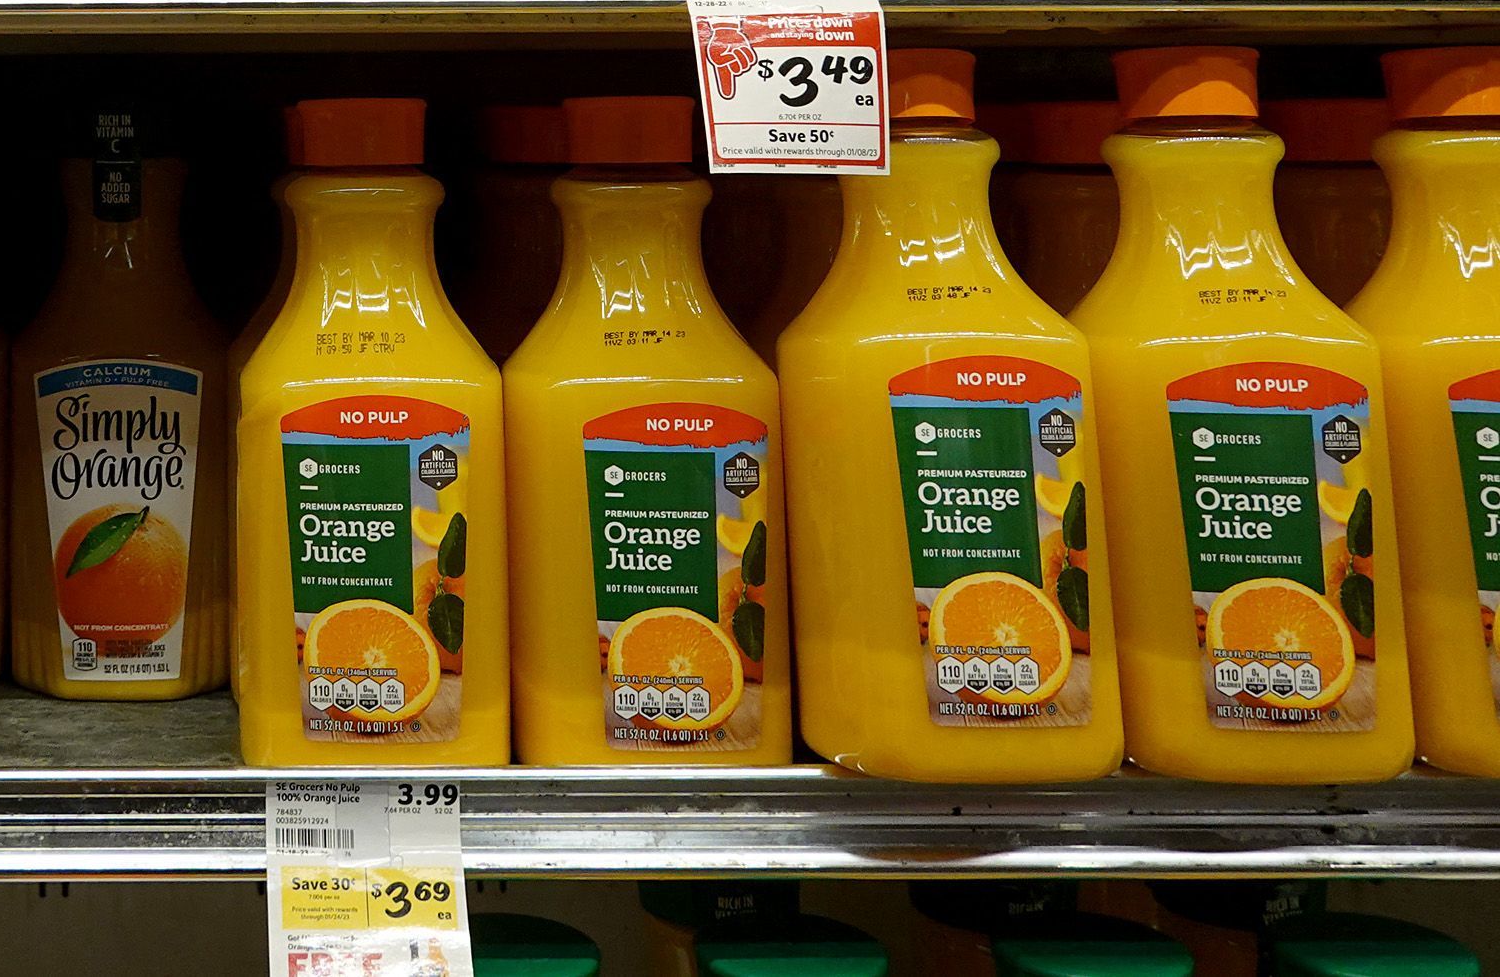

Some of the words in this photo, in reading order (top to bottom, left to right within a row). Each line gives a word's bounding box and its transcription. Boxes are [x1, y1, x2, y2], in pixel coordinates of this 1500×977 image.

[856, 95, 874, 106] ea
[769, 130, 806, 142] Save
[317, 334, 338, 345] BEST
[343, 334, 354, 344] BY
[359, 333, 376, 343] MAR
[381, 332, 391, 342] 10
[1236, 379, 1261, 391] NO
[1265, 380, 1308, 391] PULP
[340, 411, 365, 423] NO
[368, 411, 409, 423] PULP
[54, 394, 186, 454] Simply
[52, 449, 183, 500] Orange
[319, 464, 360, 474] GROCERS
[1195, 488, 1301, 513] Orange
[343, 503, 403, 511] PASTEURIZED
[300, 515, 395, 541] Orange
[1199, 515, 1272, 539] Juice
[301, 540, 366, 563] Juice
[313, 685, 329, 697] 110
[289, 783, 323, 791] Grocers
[341, 784, 360, 793] Pulp
[398, 784, 458, 805] 3.99
[292, 878, 327, 890] Save
[438, 911, 452, 920] ea
